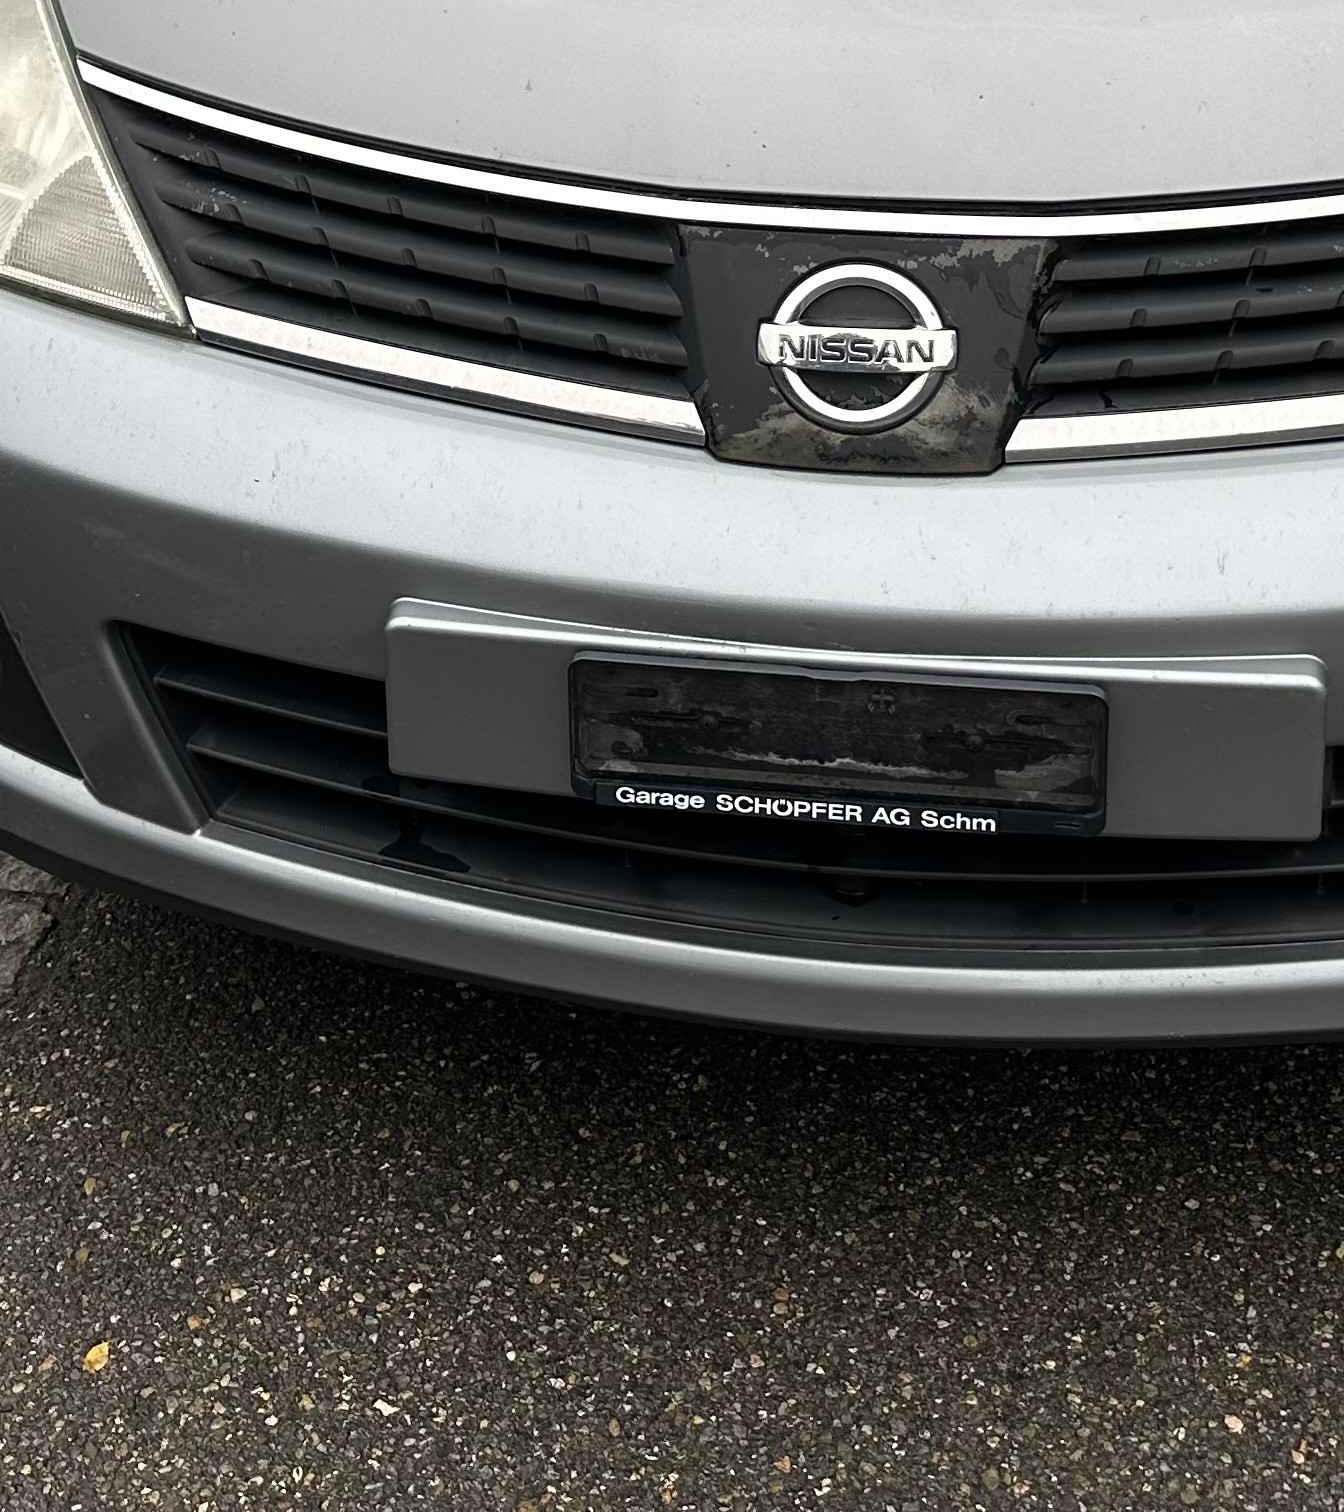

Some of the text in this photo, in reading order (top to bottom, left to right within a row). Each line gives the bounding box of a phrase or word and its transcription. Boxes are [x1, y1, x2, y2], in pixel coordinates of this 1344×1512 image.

[778, 333, 935, 364] NISSAN
[615, 786, 997, 833] Garage SCHÖPFER AG Schm
